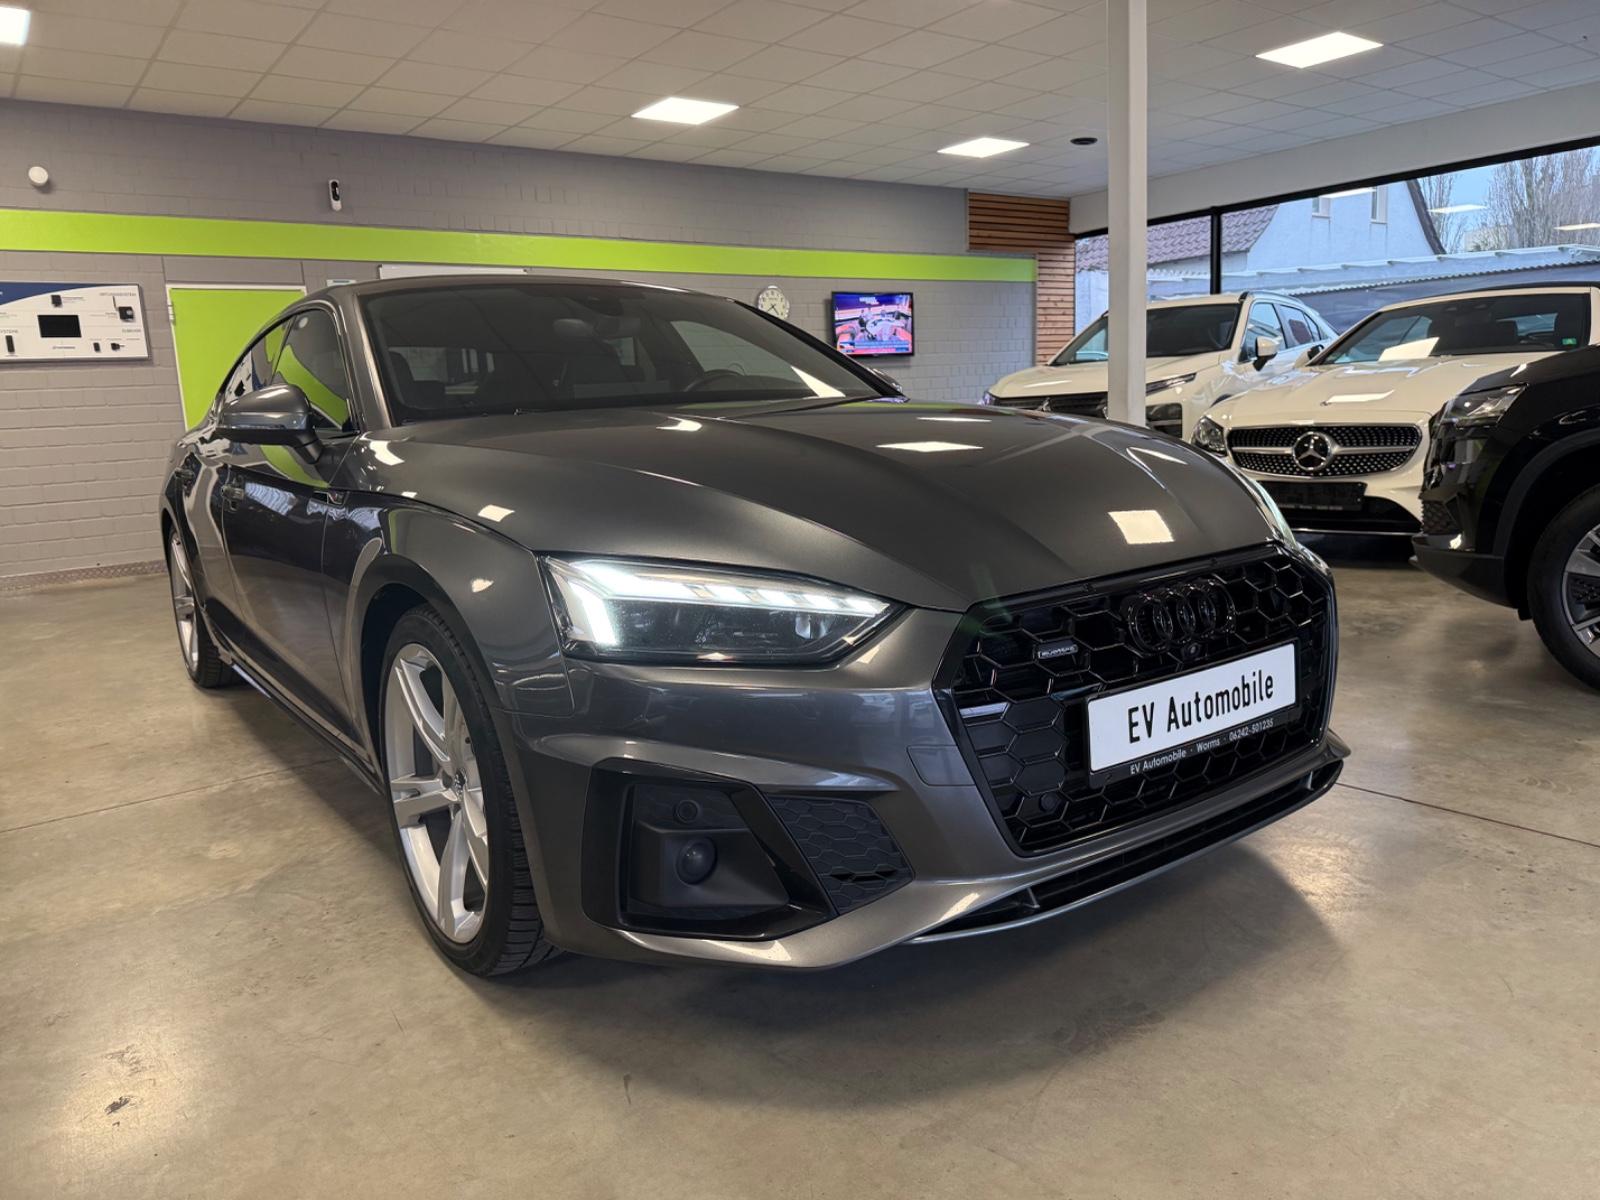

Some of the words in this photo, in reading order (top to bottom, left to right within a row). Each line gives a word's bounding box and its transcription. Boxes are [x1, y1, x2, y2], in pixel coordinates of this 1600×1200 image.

[1128, 702, 1155, 744] EV
[1167, 669, 1274, 733] Automobile
[1130, 763, 1141, 775] EV
[1142, 748, 1187, 771] Automobile
[1195, 738, 1220, 752] Worms
